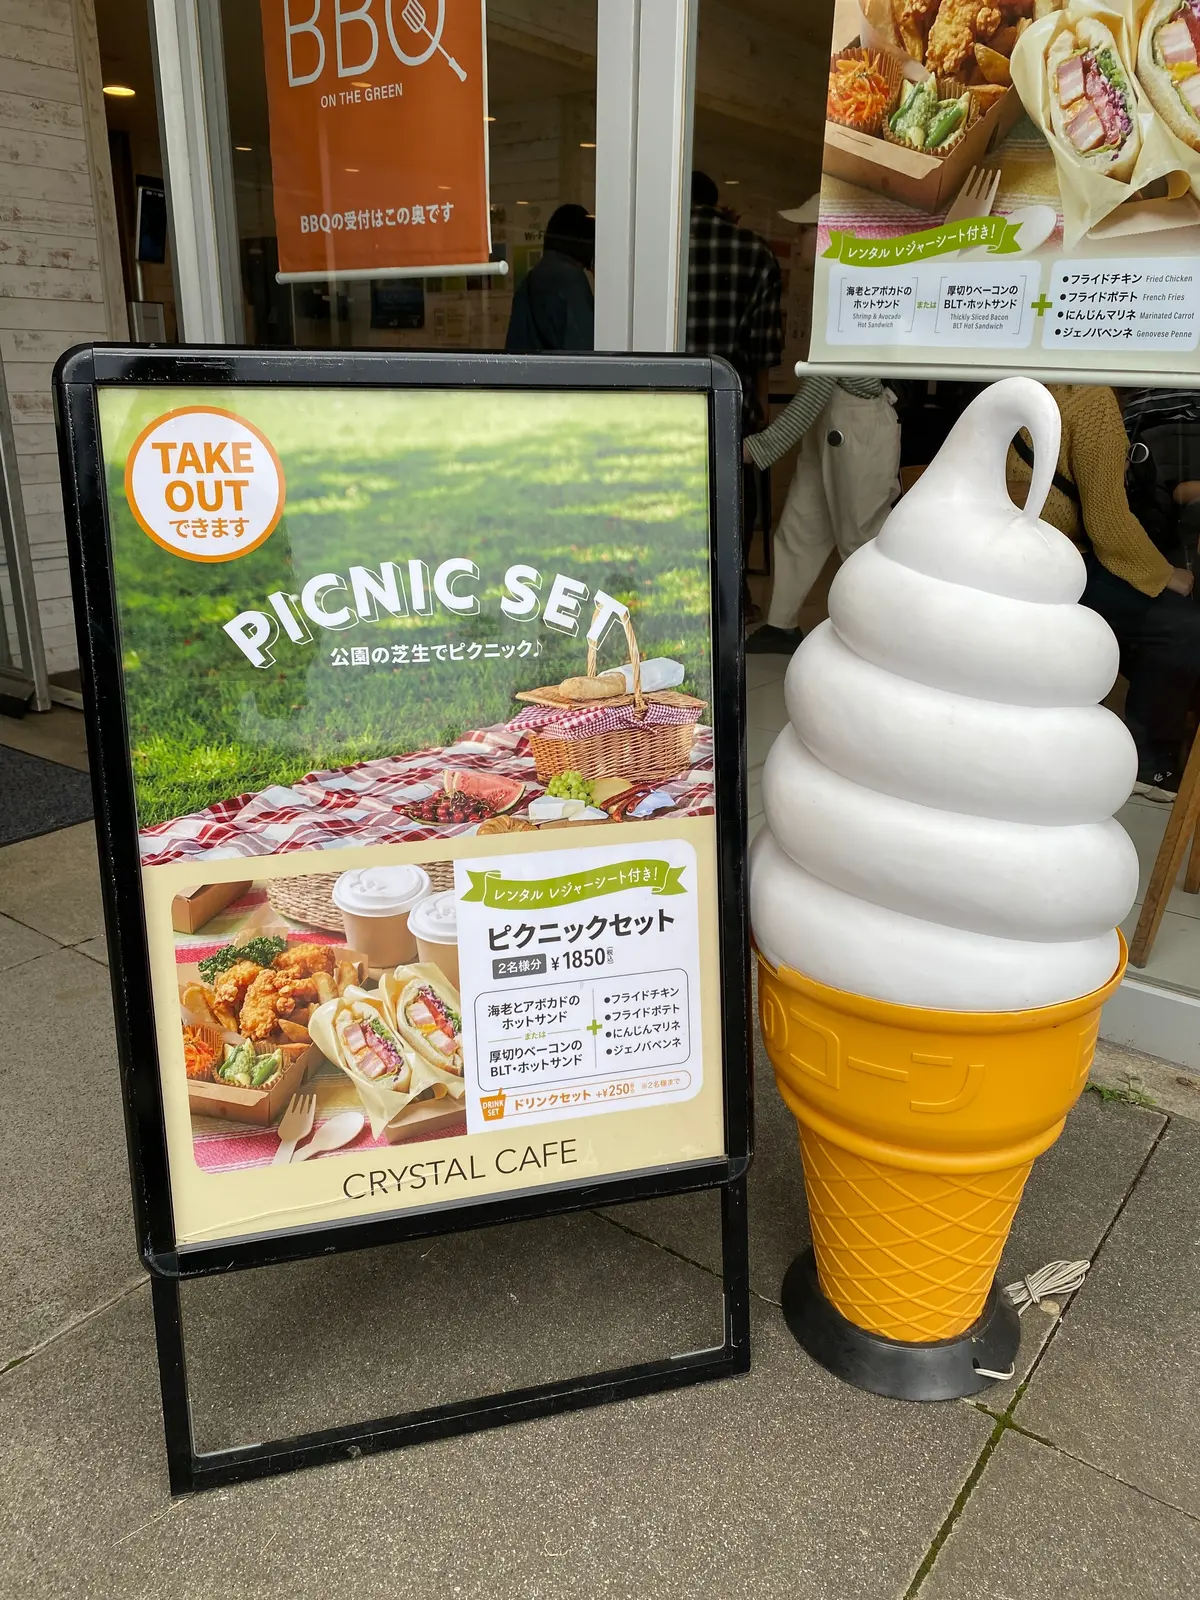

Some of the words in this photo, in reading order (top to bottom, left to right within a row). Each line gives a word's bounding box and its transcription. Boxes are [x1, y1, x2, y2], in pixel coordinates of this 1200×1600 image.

[284, 0, 446, 87] BBQ
[320, 93, 337, 109] ON
[339, 89, 361, 105] THE
[364, 82, 403, 102] GREEN
[300, 201, 454, 234] BBQの受付はこの奥です
[847, 247, 891, 261] レンタル
[1071, 273, 1143, 285] フライドチキン
[1145, 275, 1164, 283] Fried
[1164, 274, 1193, 283] Chicken
[846, 286, 912, 296] 海老とアボカドの
[946, 285, 1019, 296] 厚切りベーコンの
[1068, 291, 1138, 302] フライドポテト
[1142, 293, 1166, 301] French
[1167, 293, 1185, 301] Fries
[853, 300, 900, 310] ホットサンド
[852, 312, 872, 321] Shrimp
[878, 312, 901, 320] Avocado
[950, 313, 970, 322] Thickly
[970, 313, 990, 321] Sliced
[990, 313, 1009, 321] Bacon
[1065, 309, 1136, 320] にんじんマリネ
[1139, 311, 1173, 320] Marinated
[1173, 311, 1195, 320] Carrot
[974, 321, 1004, 330] Sandwich
[1136, 330, 1169, 338] Genovese
[1170, 330, 1193, 338] Penne
[151, 441, 254, 475] TAKE
[164, 479, 250, 513] OUT
[168, 516, 250, 539] できます
[222, 557, 481, 670] PICNIC
[500, 564, 631, 652] SET
[493, 889, 544, 902] レンタル
[488, 908, 675, 952] ピクニックセット
[498, 958, 542, 975] 2名様分
[611, 986, 680, 1004] フライドチキン
[487, 995, 580, 1017] 海老とアボカドの
[612, 1003, 681, 1021] フライドポテト
[502, 1010, 568, 1031] ホットサンド
[613, 1020, 682, 1039] にんじんマリネ
[524, 1031, 547, 1041] または
[489, 1039, 583, 1064] 厚切りベーコンの
[613, 1037, 682, 1056] ジェノバペンネ
[482, 1099, 504, 1110] DRINK
[514, 1089, 591, 1111] ドリンクセット
[487, 1108, 500, 1117] SET
[343, 1155, 486, 1200] CRYSTAL
[495, 1138, 578, 1175] CAFE
